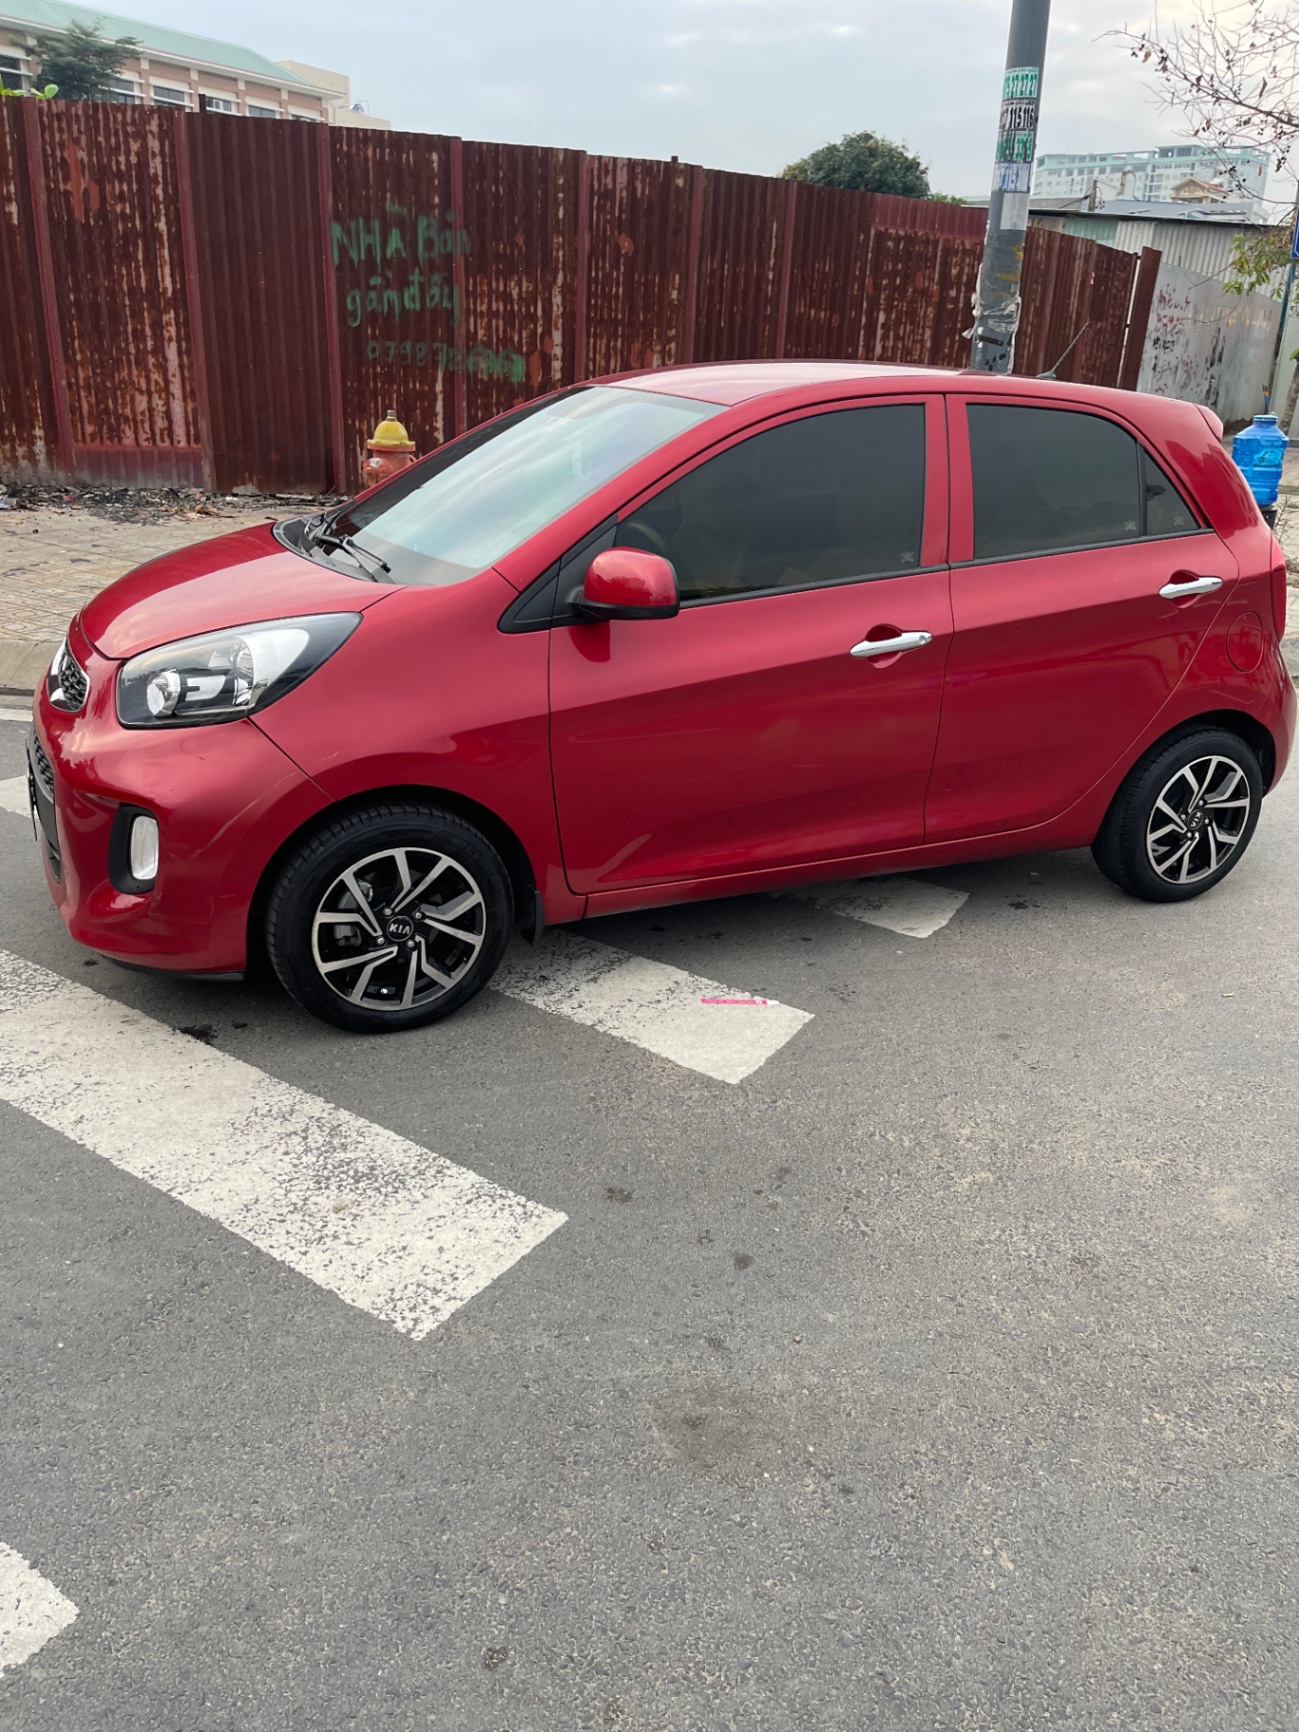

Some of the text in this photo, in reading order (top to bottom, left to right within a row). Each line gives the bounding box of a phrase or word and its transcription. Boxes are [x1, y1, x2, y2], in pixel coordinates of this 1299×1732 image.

[330, 201, 408, 272] NHÀ
[1190, 811, 1202, 828] KIA
[389, 923, 411, 935] KIA
